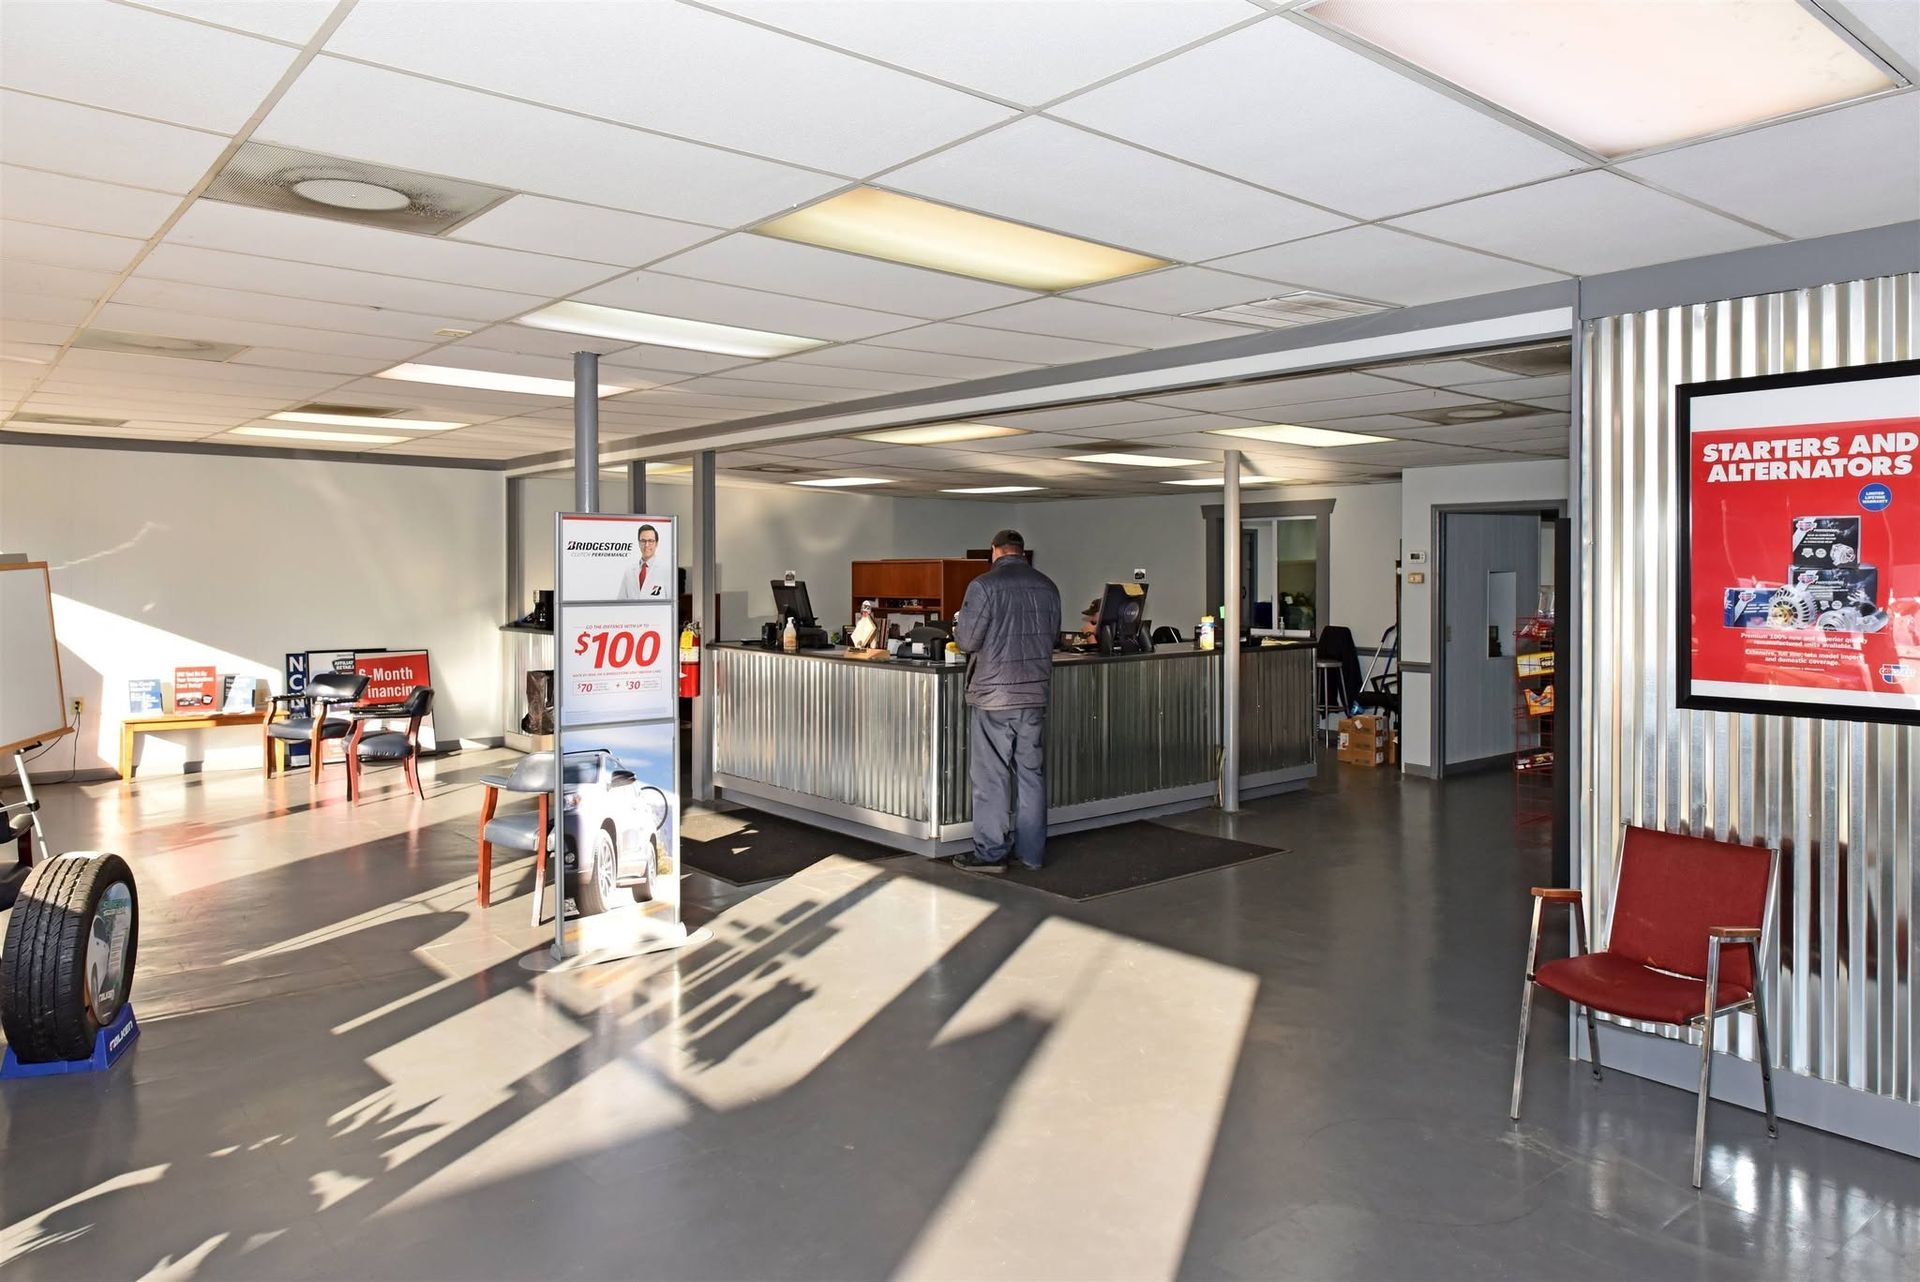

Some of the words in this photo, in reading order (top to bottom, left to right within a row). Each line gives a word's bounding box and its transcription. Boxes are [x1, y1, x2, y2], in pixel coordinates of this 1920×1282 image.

[1703, 436, 1840, 463] STARTERS
[1848, 432, 1919, 455] AND
[1707, 455, 1913, 483] ALTERNATORS
[567, 541, 633, 551] BRIDGESTONE
[575, 631, 661, 669] $100
[1808, 658, 1840, 666] coverage.
[367, 683, 416, 698] inancin
[577, 683, 593, 693] $70
[626, 680, 641, 690] $30
